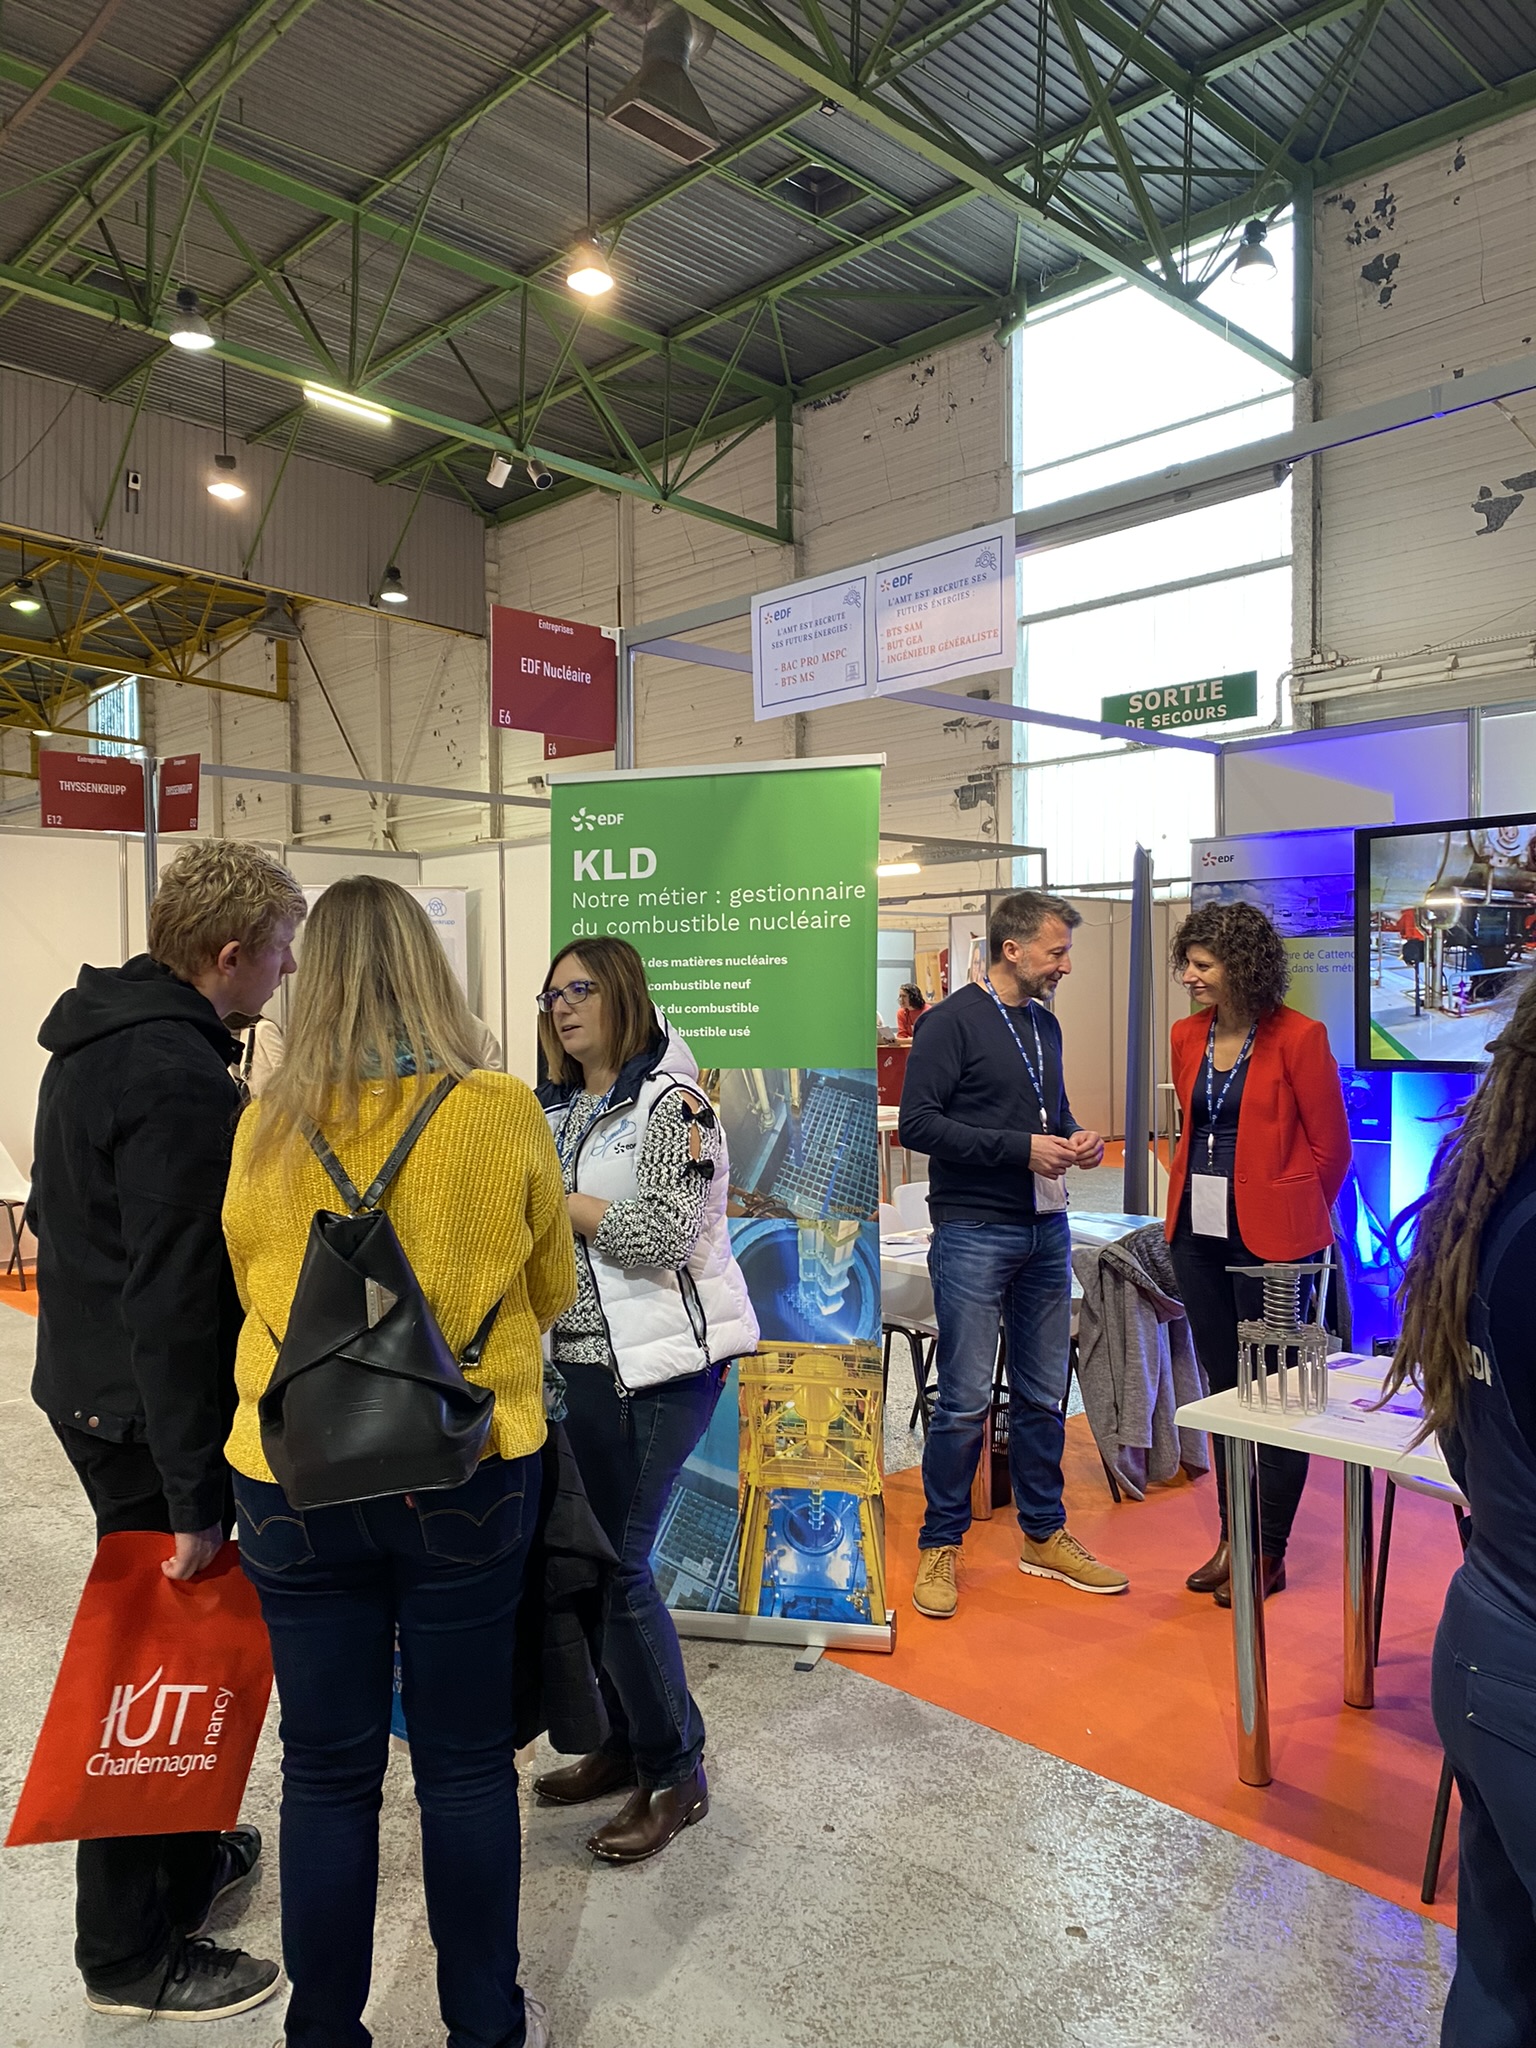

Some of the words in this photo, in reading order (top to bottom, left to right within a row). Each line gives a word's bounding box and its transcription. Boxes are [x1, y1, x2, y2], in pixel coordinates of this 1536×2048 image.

[915, 589, 931, 599] EST
[933, 579, 969, 595] RECRUTE
[971, 572, 987, 584] SES
[897, 603, 929, 617] FUTURS
[931, 590, 970, 610] ÉNERGIES
[538, 618, 574, 635] Entreprises
[799, 619, 814, 630] EST
[814, 611, 846, 627] RECRUTE
[886, 625, 902, 638] BTS
[904, 620, 923, 633] SAM
[771, 641, 784, 650] SES
[785, 632, 813, 647] FUTURS
[814, 623, 848, 640] ÉNERGIES
[887, 640, 903, 652] BUT
[905, 634, 923, 647] GEA
[887, 644, 936, 664] INGÉNIEUR
[938, 628, 999, 653] GÉNÉRALISTE
[781, 660, 798, 673] BAC
[800, 656, 819, 668] PRO
[821, 647, 848, 663] MSPC
[521, 657, 541, 675] EDF
[543, 661, 592, 684] Nucléaire
[781, 675, 797, 687] BTS
[799, 671, 815, 684] MS
[1128, 679, 1224, 714] SORTIE
[499, 709, 511, 725] E6
[1151, 704, 1228, 728] SECOURS
[548, 743, 557, 756] E6
[59, 780, 127, 796] THYSSENKRUPP
[47, 815, 63, 825] E12
[573, 847, 658, 882] KLD
[572, 892, 630, 909] Notre
[638, 886, 708, 907] métier
[716, 890, 721, 904] :
[729, 880, 866, 908] gestionnaire
[571, 917, 598, 936] du
[606, 911, 740, 935] combustible
[749, 909, 851, 931] nucléaire
[647, 957, 669, 968] des
[671, 955, 723, 967] matières
[725, 954, 788, 966] nucléaires
[1303, 949, 1315, 960] de
[1291, 965, 1314, 973] dans
[1316, 963, 1329, 972] les
[648, 980, 721, 991] combustible
[723, 978, 752, 990] neuf
[667, 1003, 683, 1014] du
[684, 1002, 760, 1014] combustible
[678, 1027, 727, 1037] bustible
[729, 1025, 751, 1037] usé
[203, 1687, 234, 1745] nancy
[85, 1750, 217, 1777] Charlemagne
